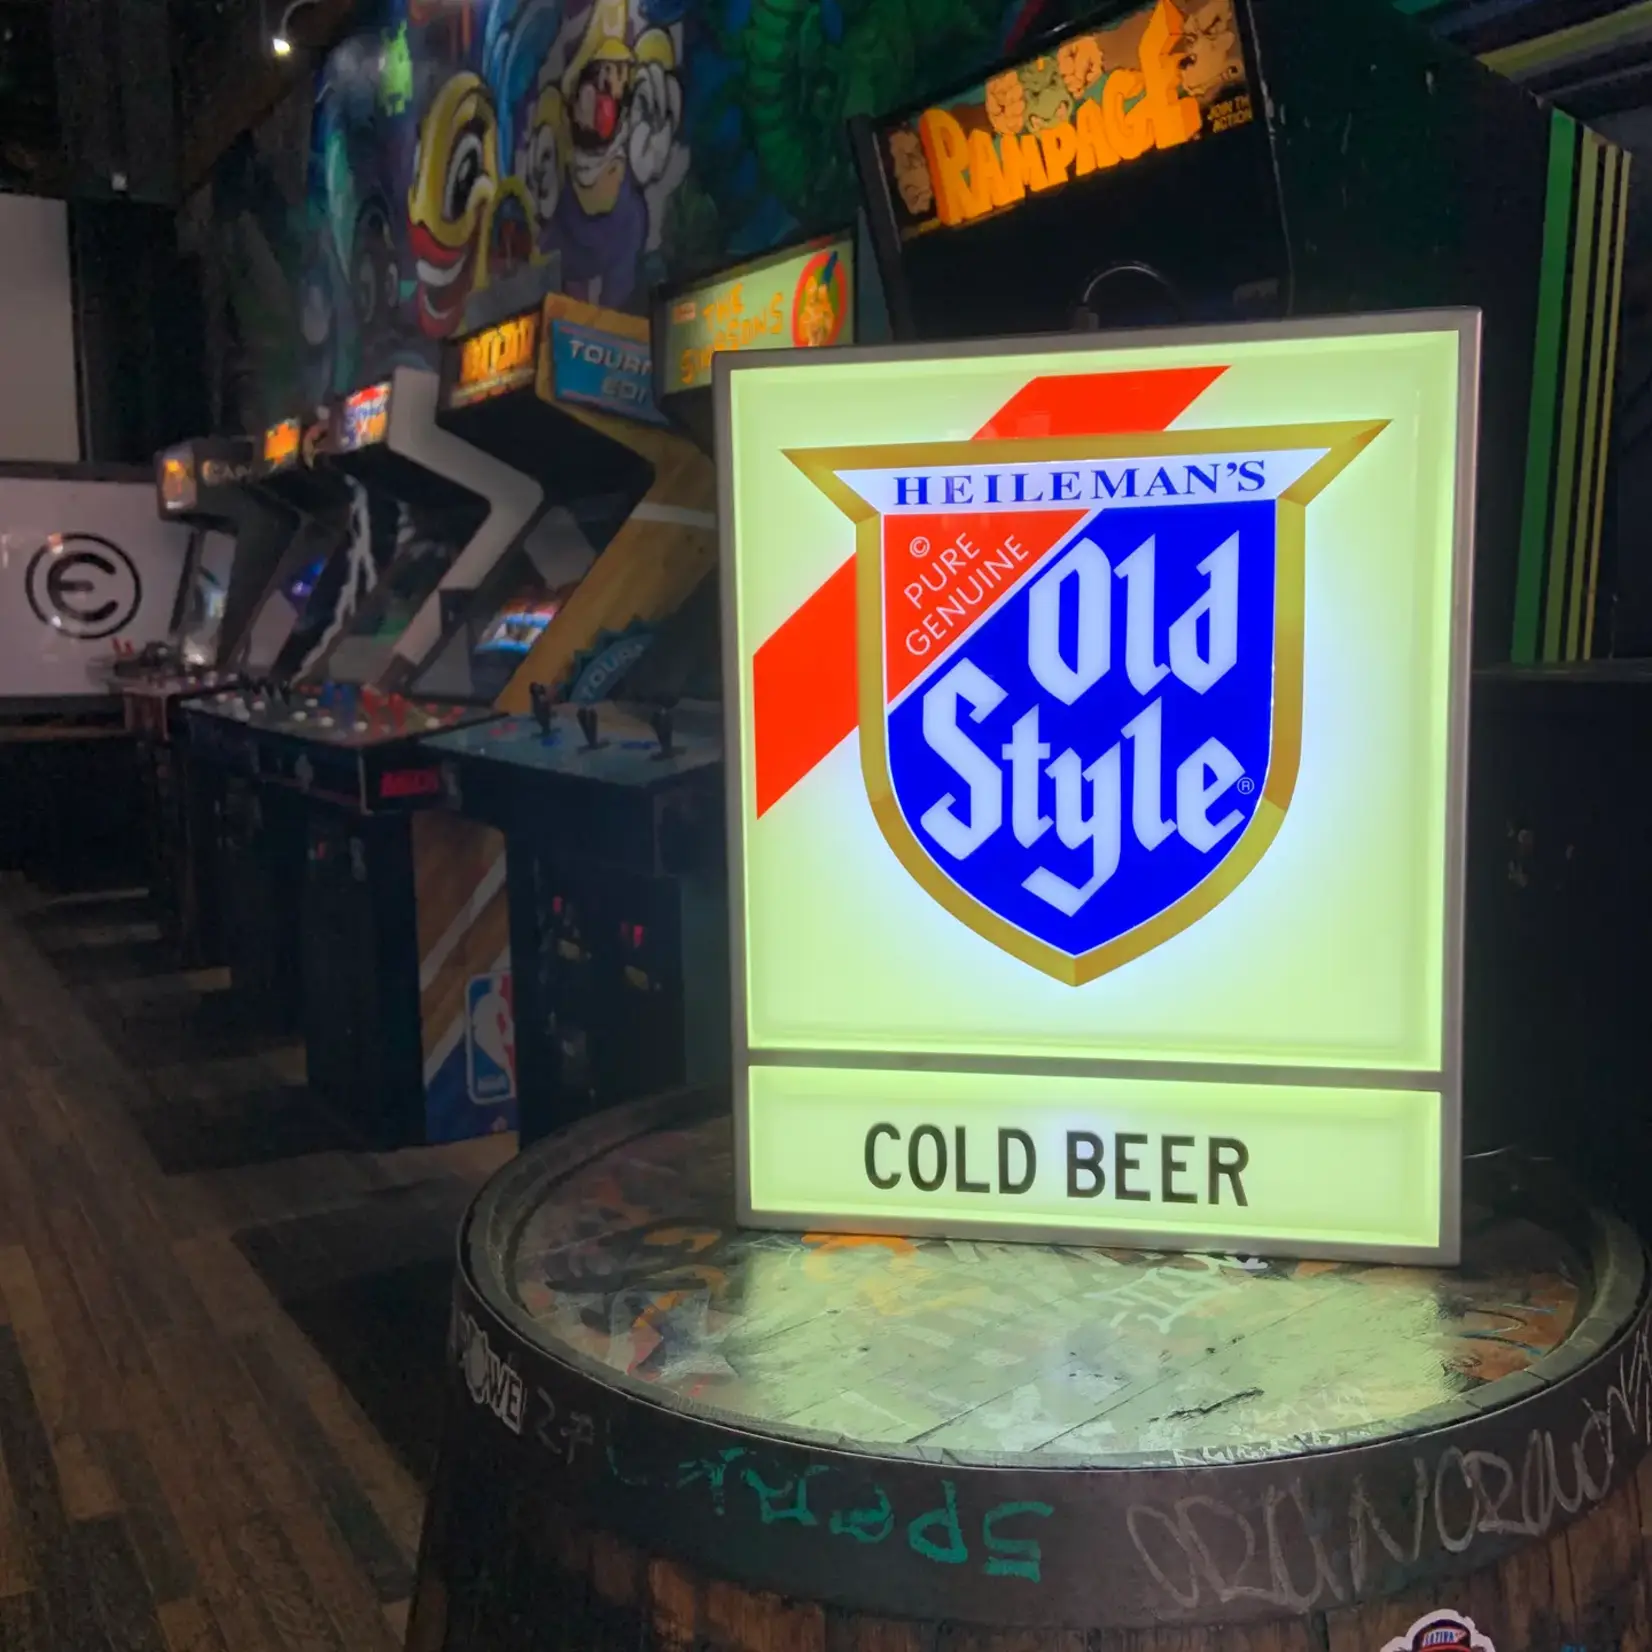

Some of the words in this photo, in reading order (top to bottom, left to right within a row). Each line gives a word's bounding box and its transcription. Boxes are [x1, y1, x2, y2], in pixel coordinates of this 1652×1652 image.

[918, 0, 1203, 225] RAMPAGE
[702, 282, 745, 332] THE
[893, 459, 1266, 506] HEILEMAN'S
[903, 532, 981, 610] PURE
[904, 534, 1030, 656] GENUINE
[1027, 529, 1240, 707] Old
[919, 656, 1247, 918] Style
[863, 1121, 1037, 1195] COLD
[1066, 1130, 1249, 1207] BEER
